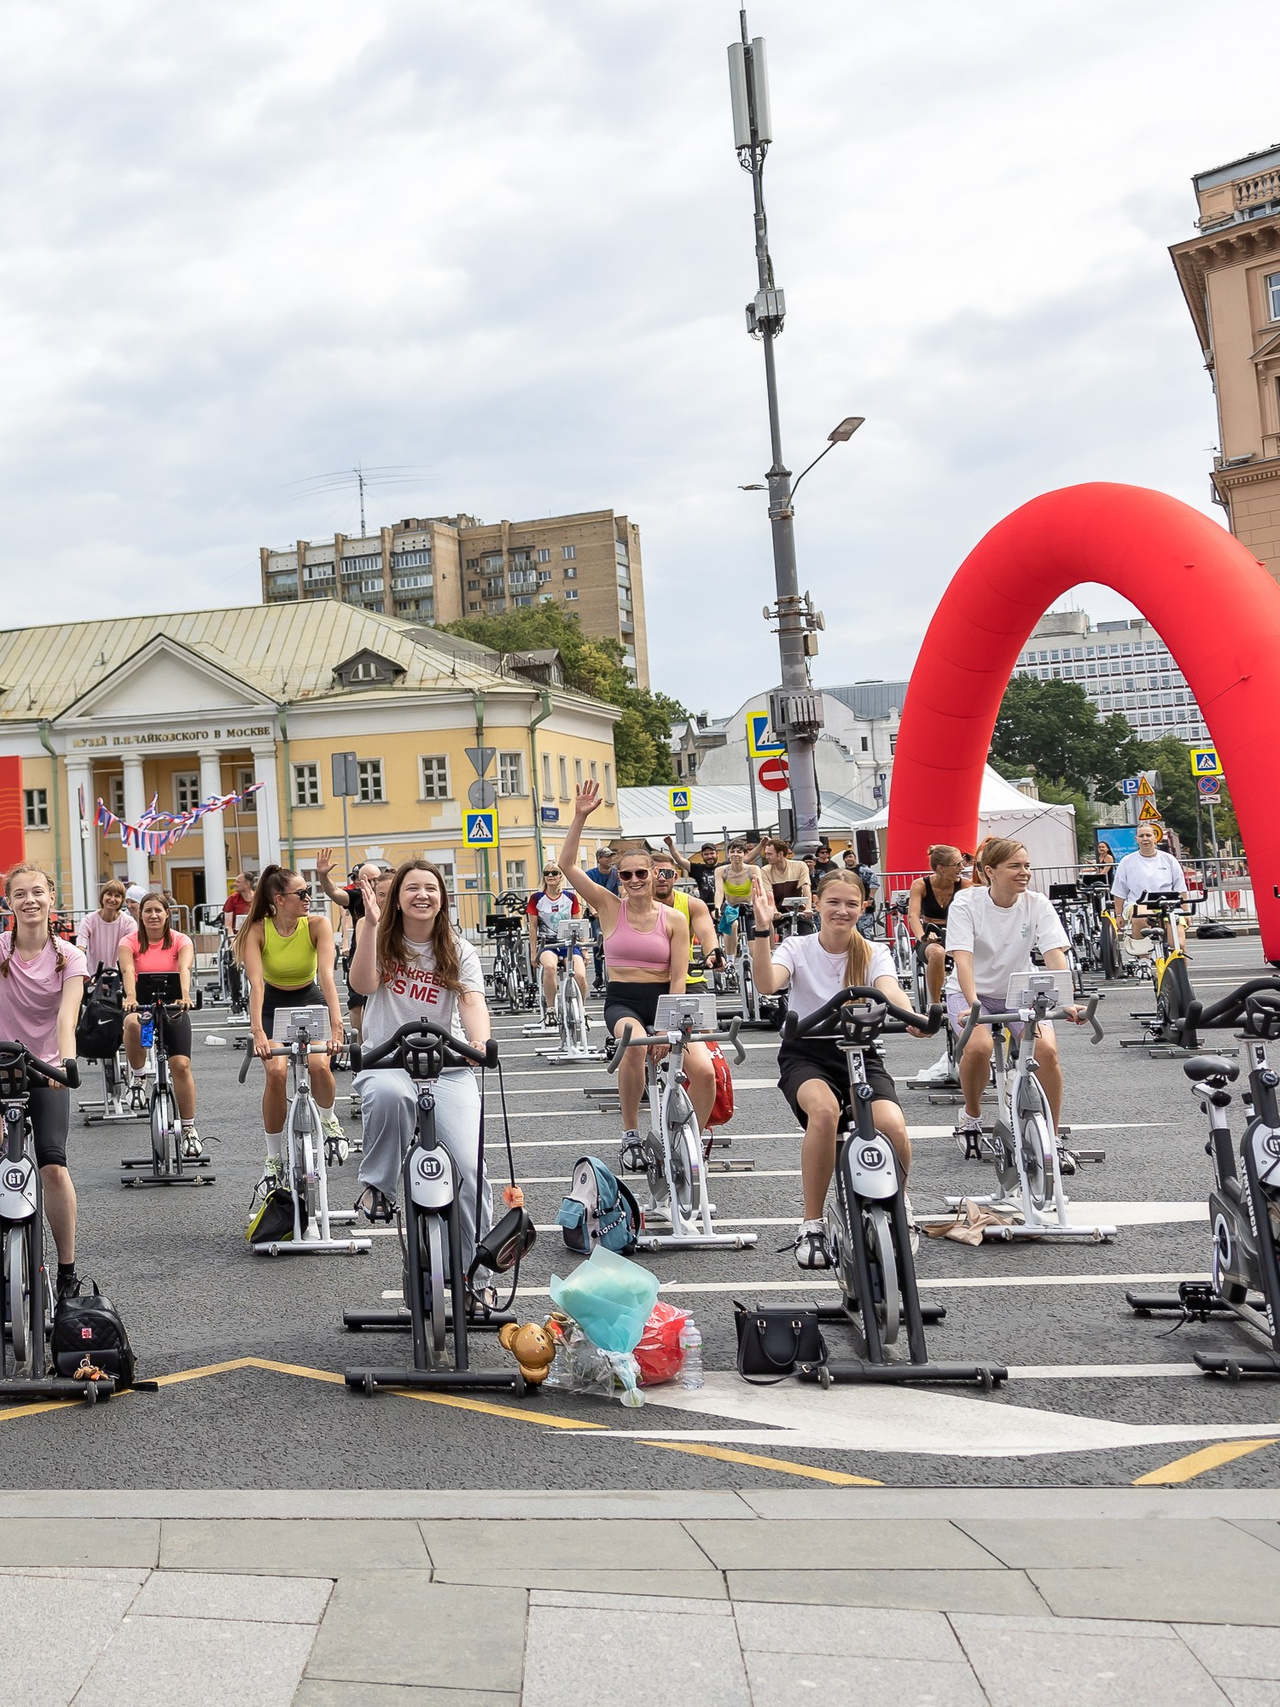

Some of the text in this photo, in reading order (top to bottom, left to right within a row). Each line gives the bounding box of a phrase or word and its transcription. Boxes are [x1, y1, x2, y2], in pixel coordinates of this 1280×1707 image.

[73, 735, 108, 748] МУЗЕЙ
[214, 729, 222, 740] В
[226, 726, 271, 739] МОСКВЕ
[409, 984, 440, 1005] ME
[863, 1150, 880, 1164] GT
[423, 1161, 438, 1174] GT
[8, 1172, 22, 1185] GT
[1239, 1155, 1258, 1238] GYMTOUCH
